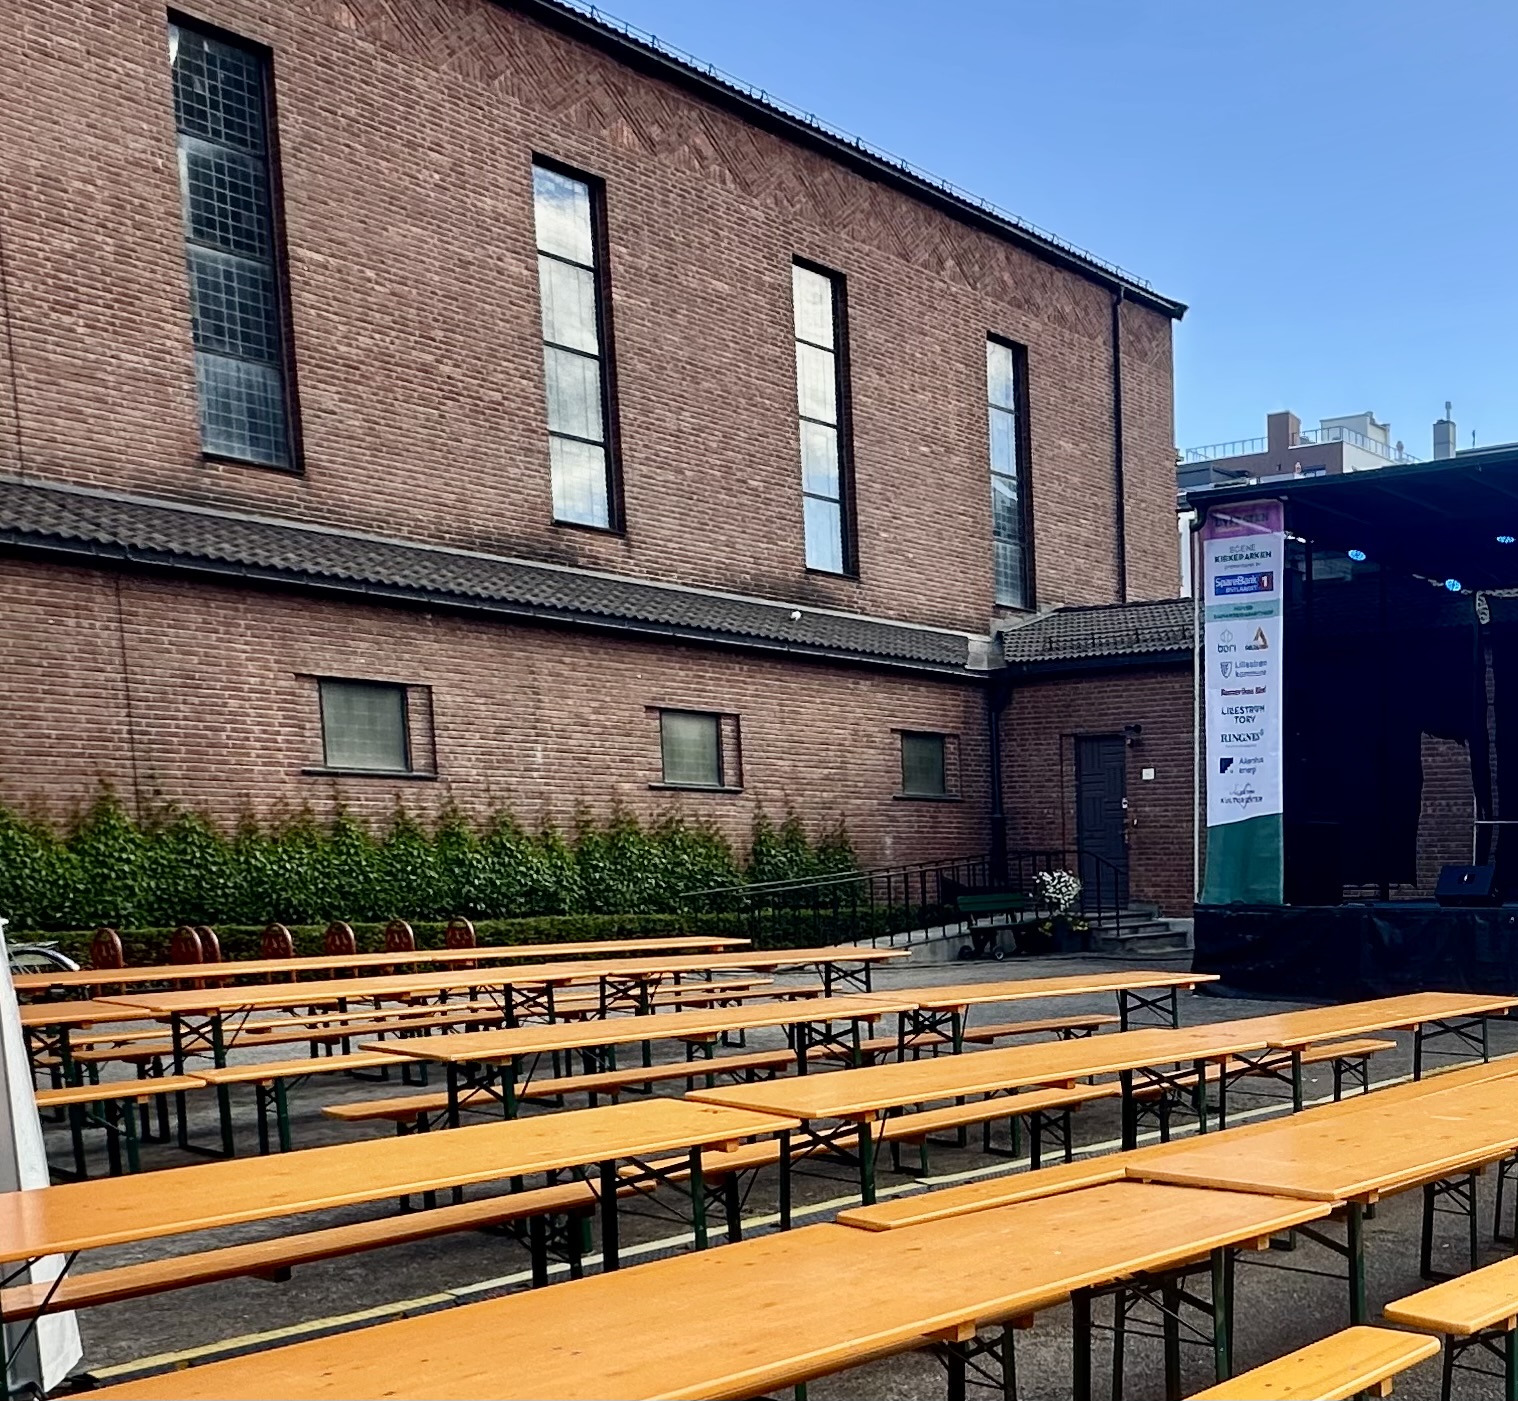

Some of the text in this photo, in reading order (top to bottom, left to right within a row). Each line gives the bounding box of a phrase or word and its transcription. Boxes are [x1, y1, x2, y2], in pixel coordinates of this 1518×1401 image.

[1215, 575, 1268, 588] SpareBank 1
[1217, 644, 1237, 653] bori
[1235, 670, 1267, 678] komm
[1234, 715, 1257, 724] TORV
[1220, 732, 1261, 743] RINGNES
